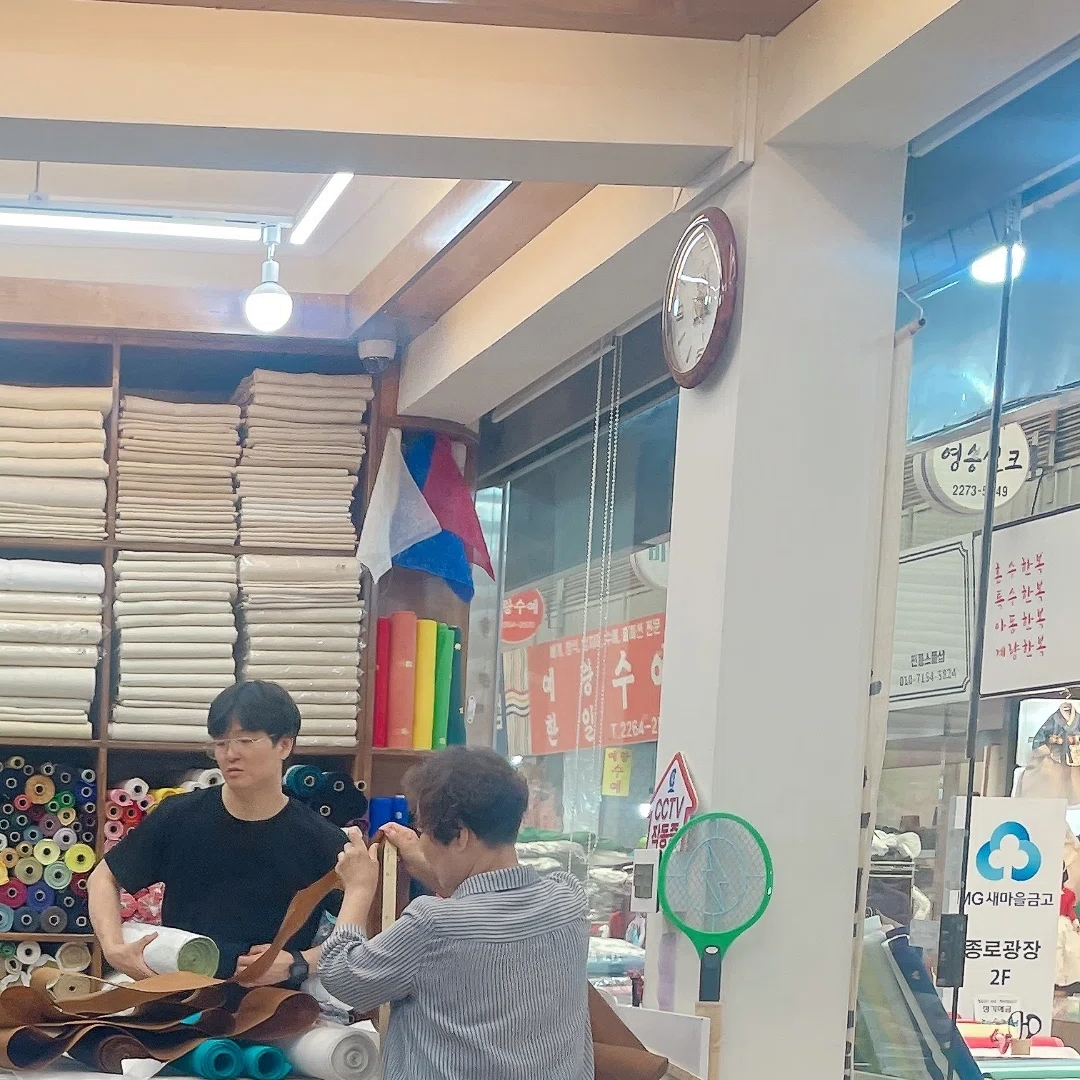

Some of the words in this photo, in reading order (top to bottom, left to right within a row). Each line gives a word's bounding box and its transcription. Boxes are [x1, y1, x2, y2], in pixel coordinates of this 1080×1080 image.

[952, 484, 1009, 498] 2273-549
[654, 795, 685, 821] CCTV
[986, 891, 1055, 907] 새마을금고
[965, 939, 1042, 960] 종로광장
[989, 968, 1012, 986] 2F
